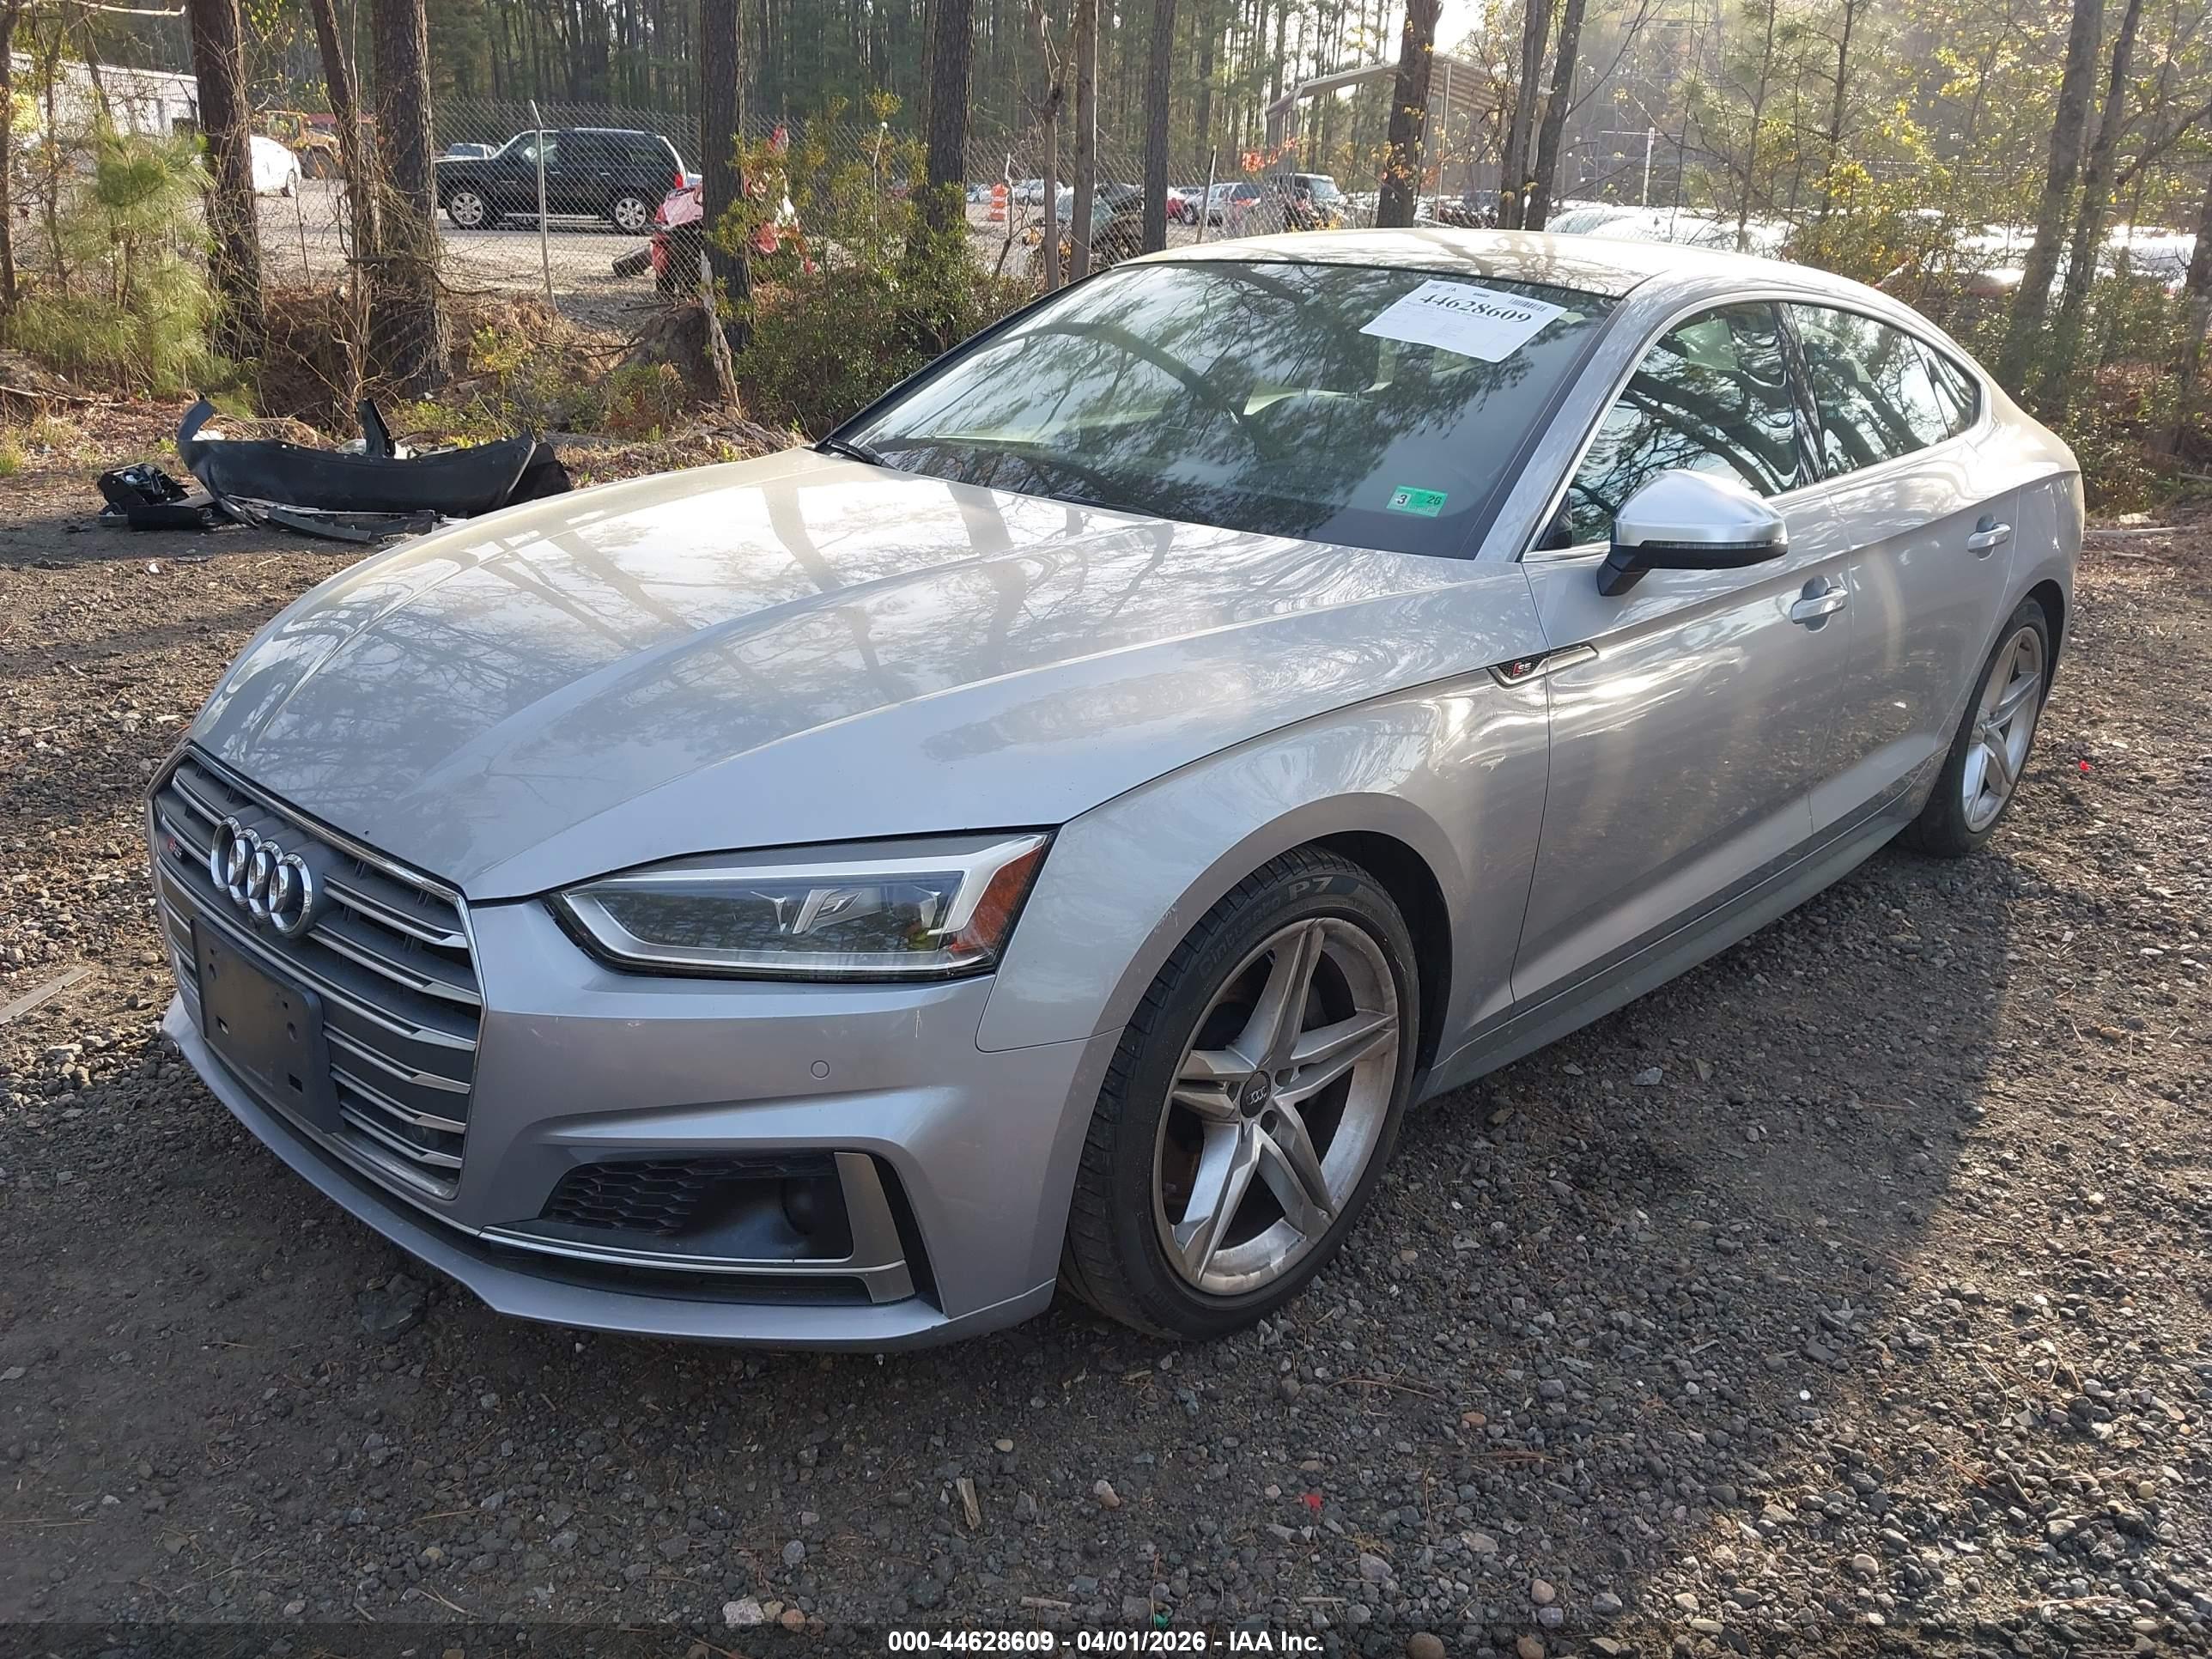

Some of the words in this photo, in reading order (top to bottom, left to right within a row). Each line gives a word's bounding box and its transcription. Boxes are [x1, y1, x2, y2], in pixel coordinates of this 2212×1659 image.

[1419, 293, 1533, 324] 44628609
[1397, 494, 1408, 505] 3
[1426, 495, 1443, 506] 26
[1288, 876, 1334, 901] P7
